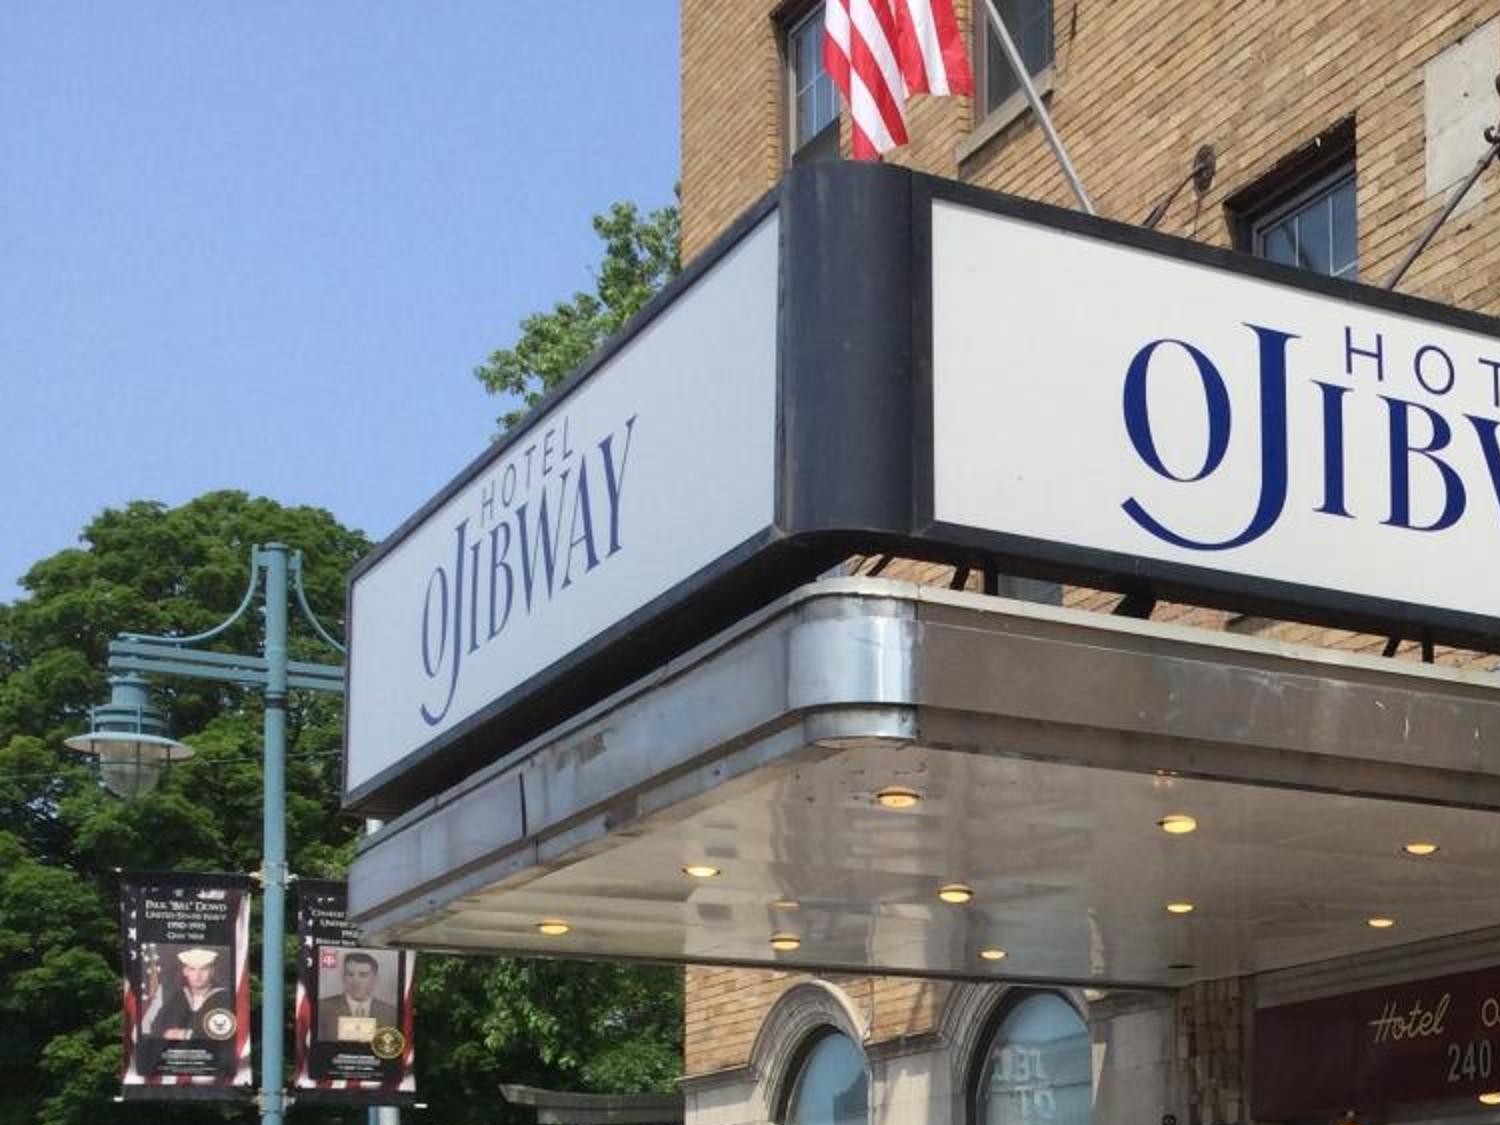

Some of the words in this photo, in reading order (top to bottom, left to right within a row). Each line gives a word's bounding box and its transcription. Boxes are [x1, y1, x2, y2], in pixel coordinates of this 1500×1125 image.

[481, 415, 573, 526] HOTEL
[420, 414, 638, 726] OJIBWAY
[1368, 993, 1451, 1043] Hotel
[1448, 1040, 1492, 1082] 240
